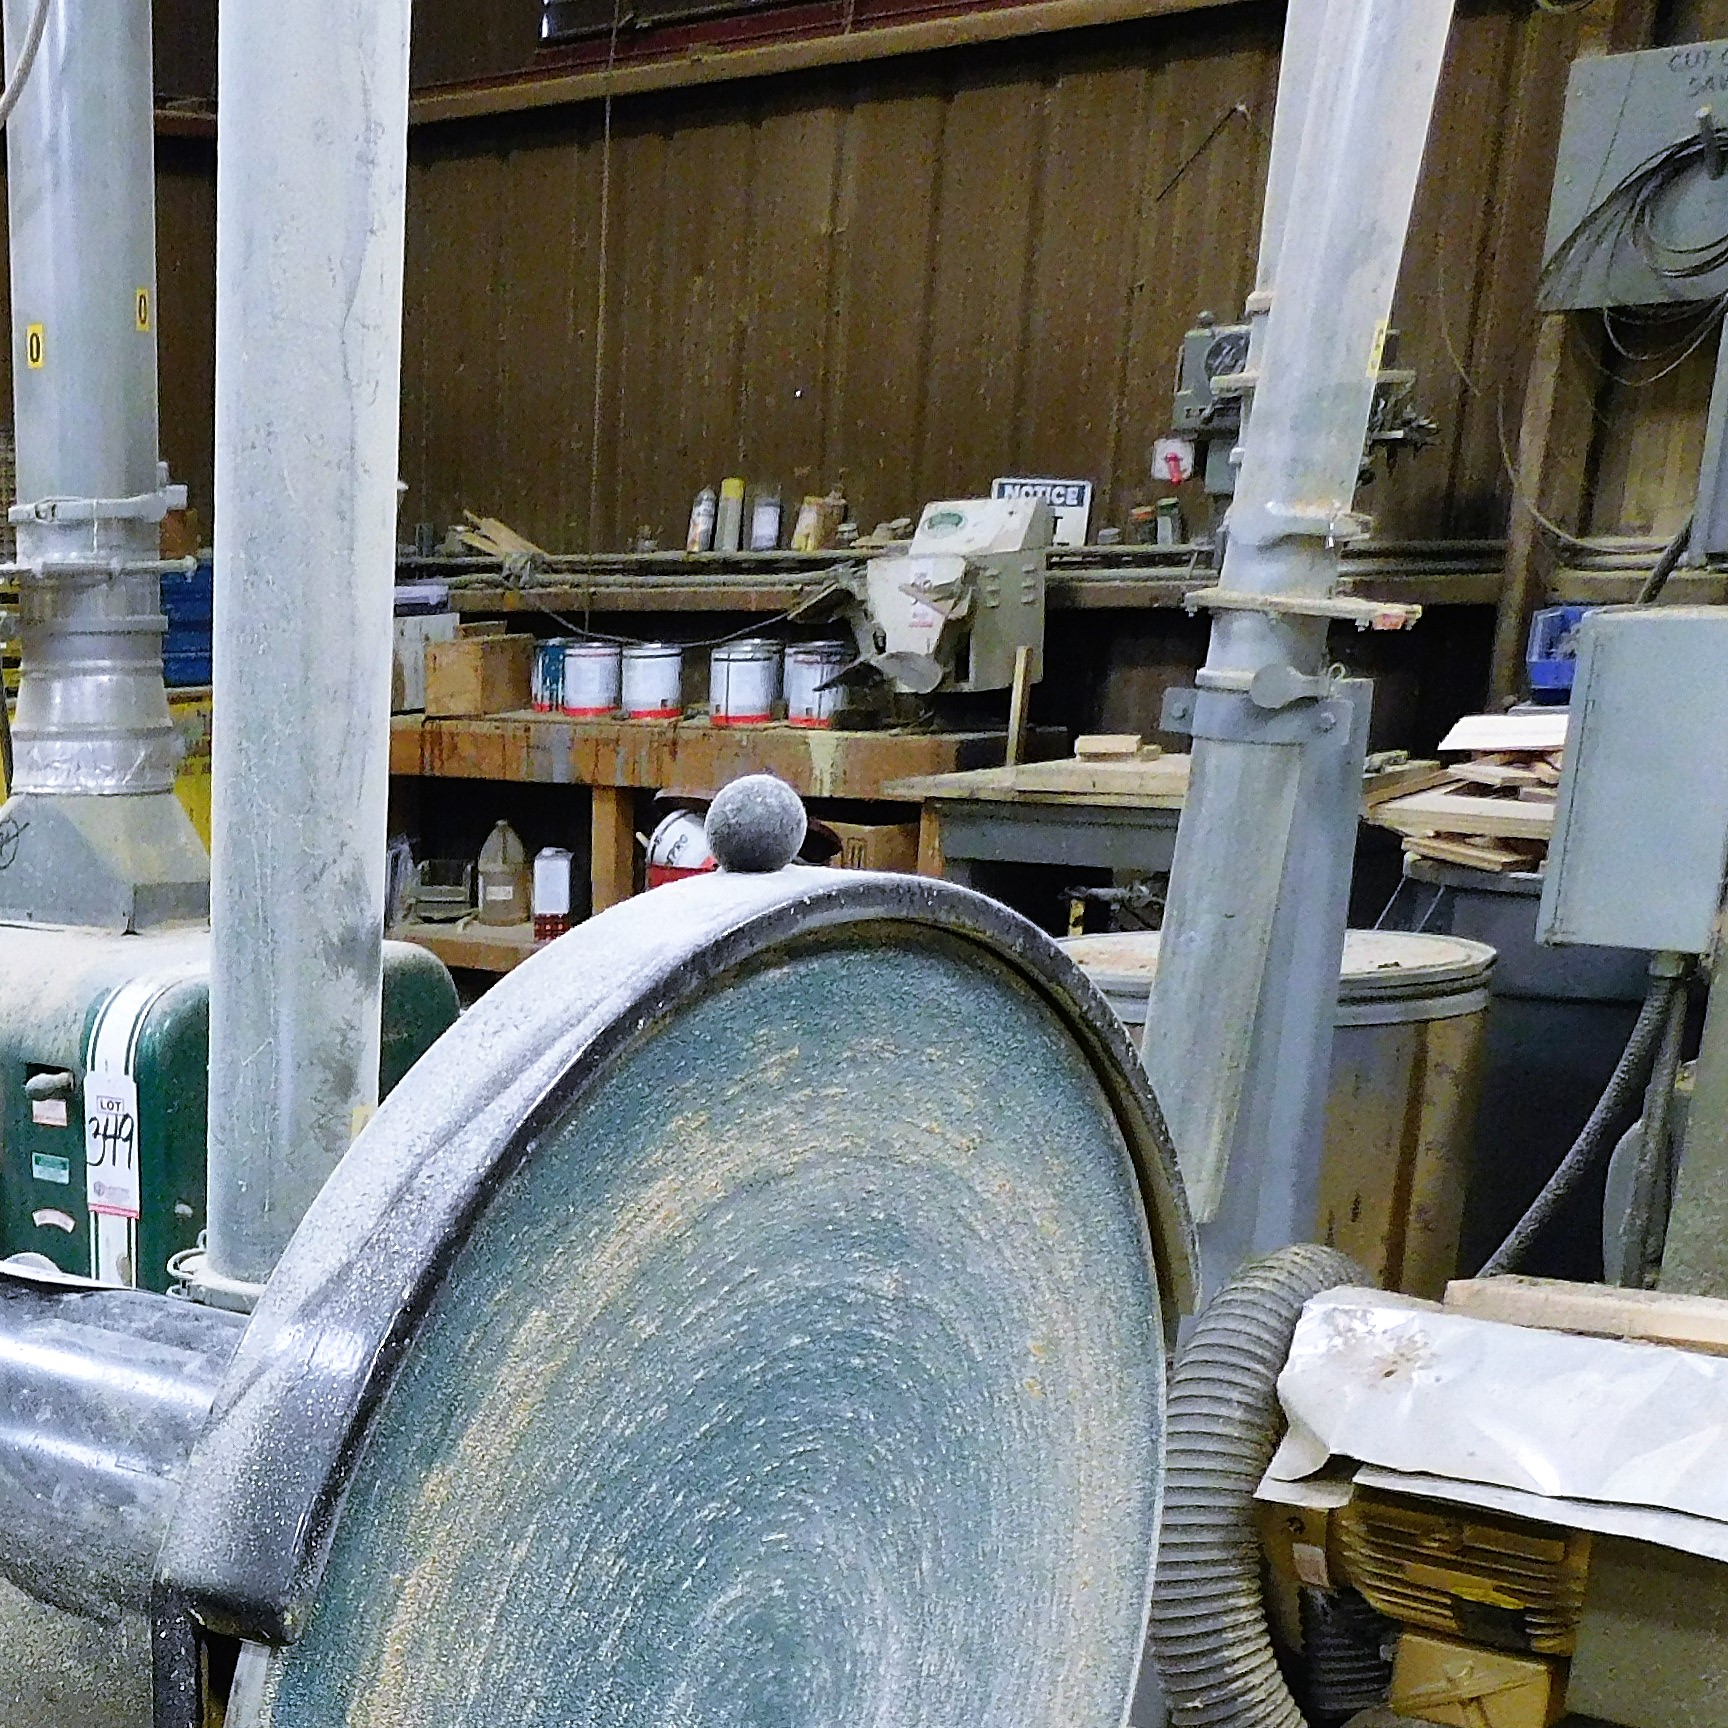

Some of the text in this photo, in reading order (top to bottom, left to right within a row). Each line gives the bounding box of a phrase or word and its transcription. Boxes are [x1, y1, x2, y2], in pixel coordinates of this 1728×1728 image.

[29, 332, 40, 363] 0
[1004, 484, 1080, 506] NOTICE
[100, 1102, 122, 1113] LOT
[86, 1113, 135, 1170] 349
